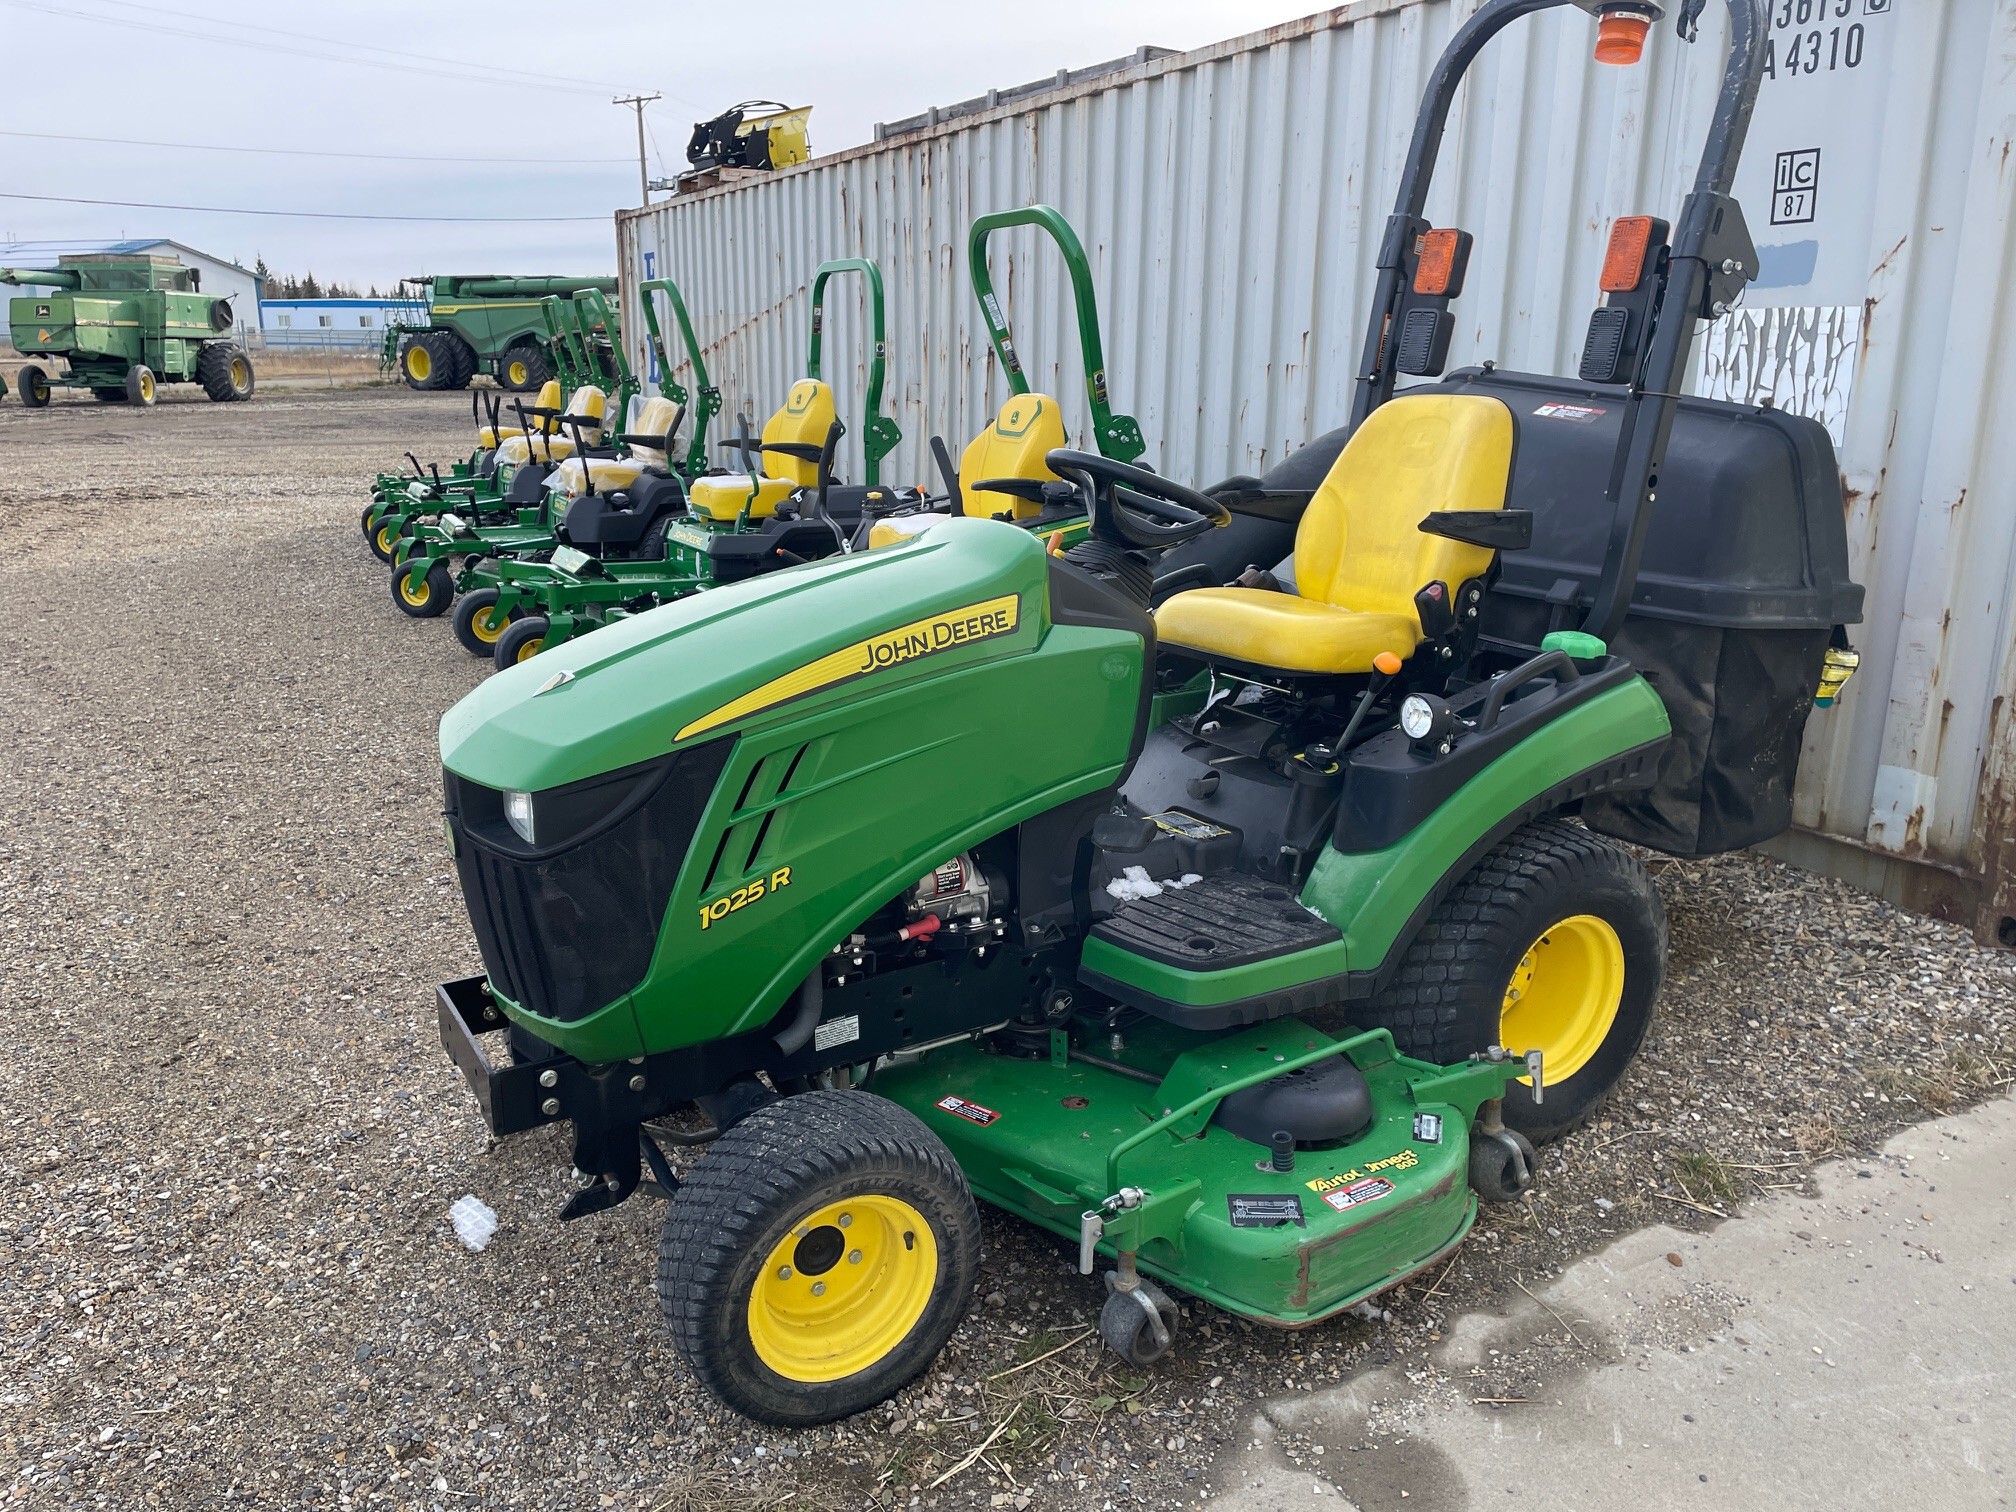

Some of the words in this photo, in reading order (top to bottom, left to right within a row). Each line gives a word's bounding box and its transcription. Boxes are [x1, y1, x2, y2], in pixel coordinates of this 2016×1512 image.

[1785, 23, 1865, 77] 4310
[1784, 194, 1805, 217] 87
[861, 631, 929, 671] JOHN
[932, 609, 1009, 647] DEERE
[699, 878, 767, 931] 1025
[770, 866, 793, 893] R
